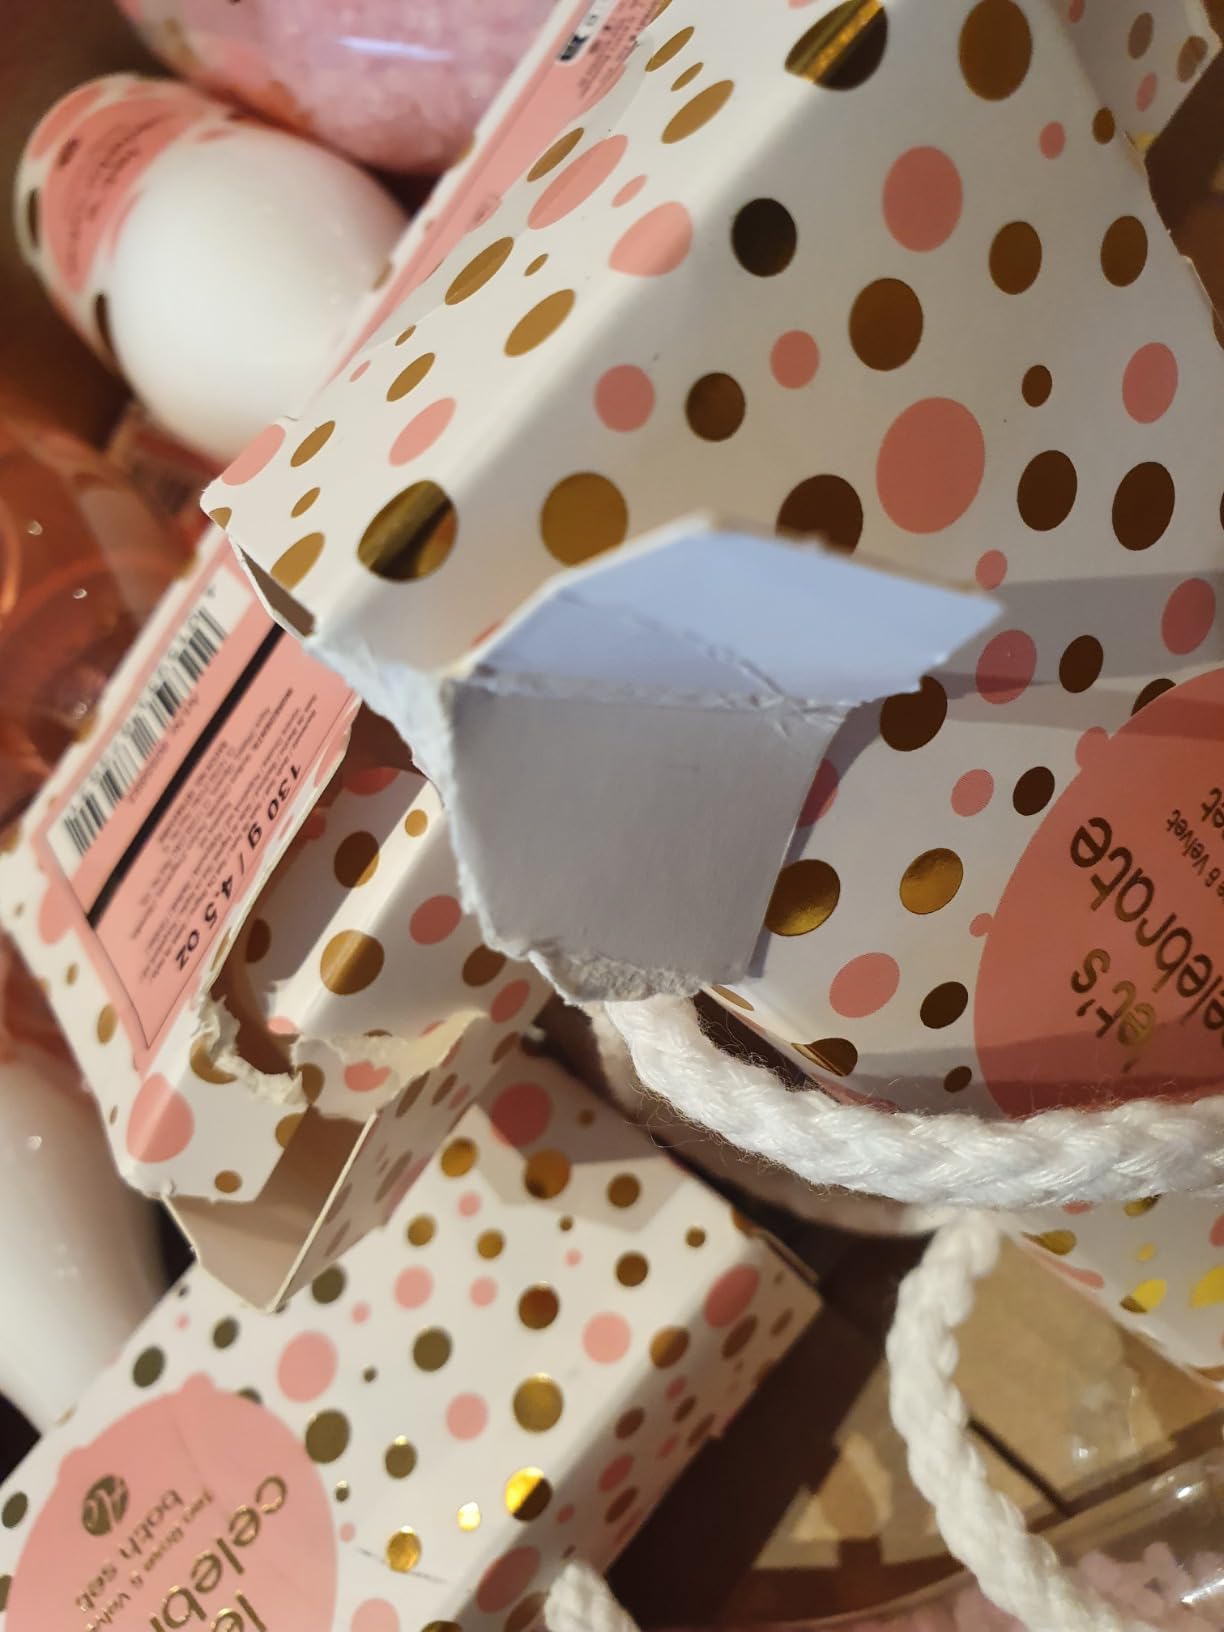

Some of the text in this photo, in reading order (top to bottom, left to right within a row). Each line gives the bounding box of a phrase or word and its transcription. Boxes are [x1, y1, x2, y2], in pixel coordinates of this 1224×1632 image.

[267, 764, 301, 821] 130
[248, 822, 262, 849] g
[1166, 809, 1210, 876] Velvet
[204, 875, 233, 930] 4.5
[175, 929, 200, 970] oz
[1070, 817, 1224, 1049] elebrate
[1071, 949, 1156, 1074] et's
